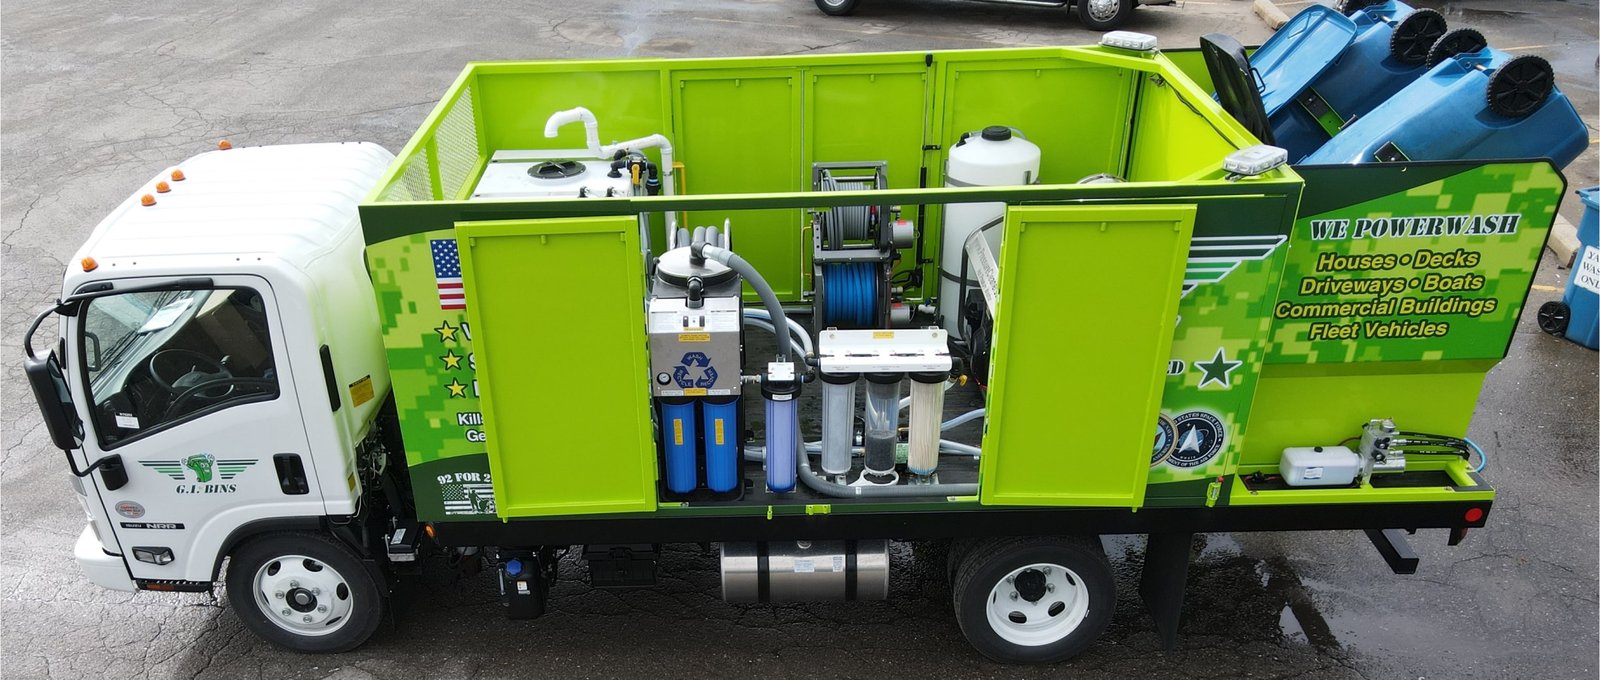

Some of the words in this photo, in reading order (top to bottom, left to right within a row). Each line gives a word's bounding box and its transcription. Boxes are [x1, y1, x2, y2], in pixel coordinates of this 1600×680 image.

[1311, 219, 1349, 240] WE
[1352, 214, 1521, 239] POWERWASH
[1317, 250, 1396, 271] Houses
[1414, 249, 1480, 269] Decks
[1300, 276, 1405, 298] Driveways
[1422, 274, 1483, 293] Boats
[1275, 299, 1395, 319] Commercial
[1399, 297, 1496, 317] Buildings
[1308, 322, 1360, 341] Fleet
[1364, 320, 1448, 339] Vehicles
[176, 484, 200, 494] G.I.
[204, 483, 237, 494] BINS
[437, 474, 453, 484] 92
[454, 472, 481, 482] FOR
